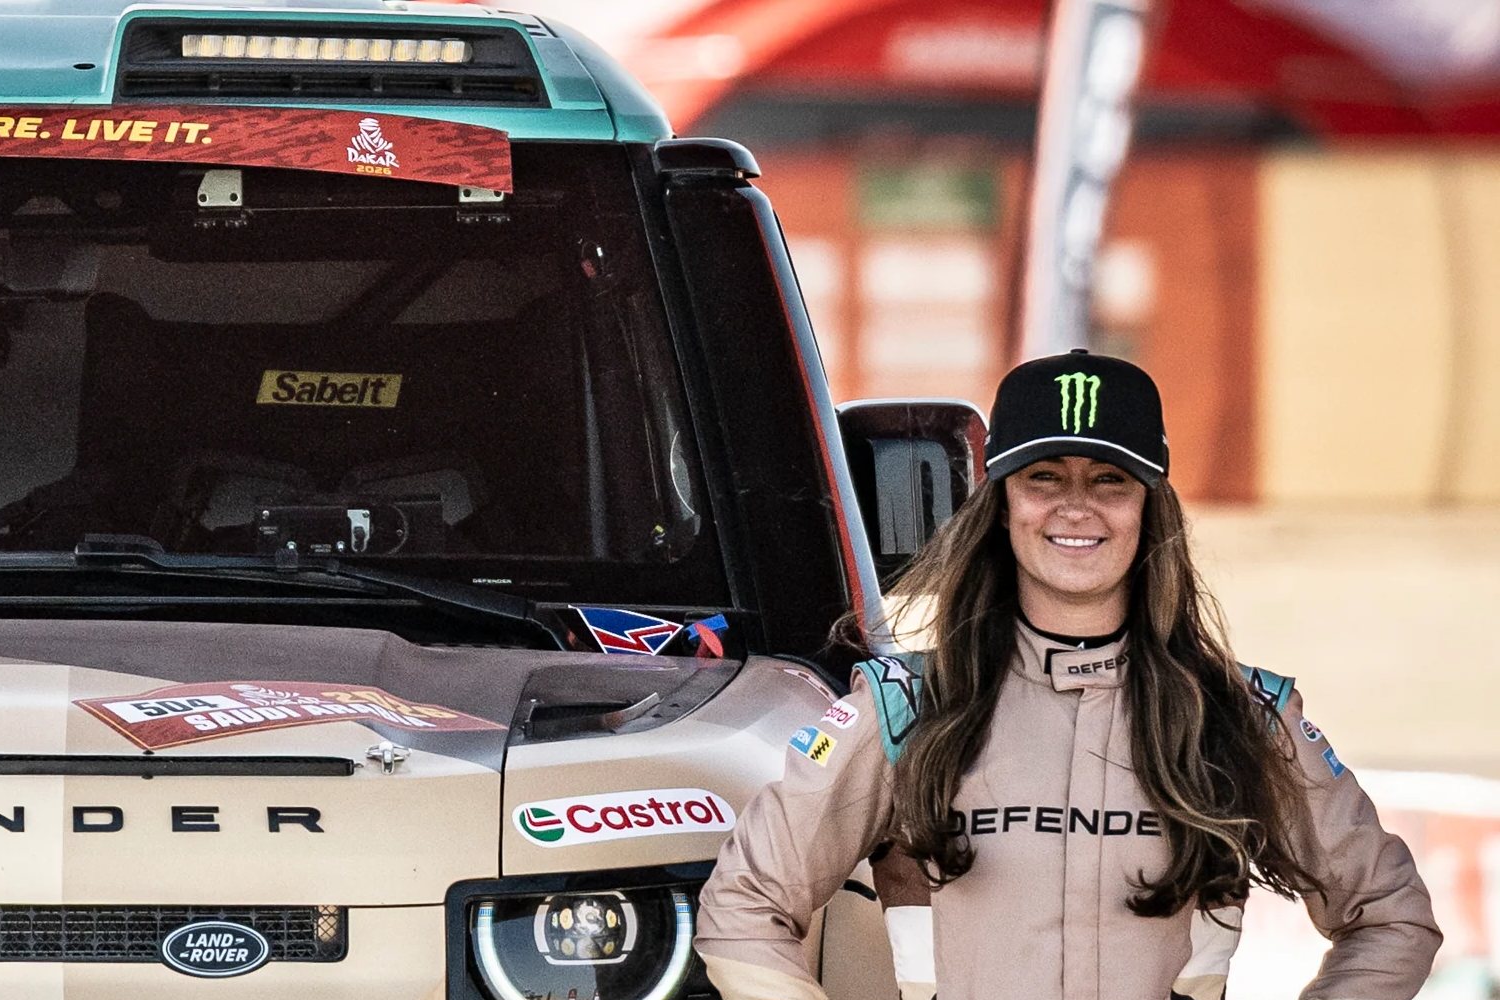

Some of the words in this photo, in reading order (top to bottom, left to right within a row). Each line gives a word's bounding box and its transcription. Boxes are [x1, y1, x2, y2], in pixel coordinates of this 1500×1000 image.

[60, 119, 155, 143] LIVE
[164, 121, 213, 144] IT.
[346, 147, 400, 168] DAKAR
[356, 164, 392, 175] 2026
[272, 372, 387, 405] Sabelt
[132, 698, 219, 717] 504
[184, 706, 301, 731] SAUDI
[566, 796, 725, 833] Castrol
[948, 806, 1162, 837] DEFENDE
